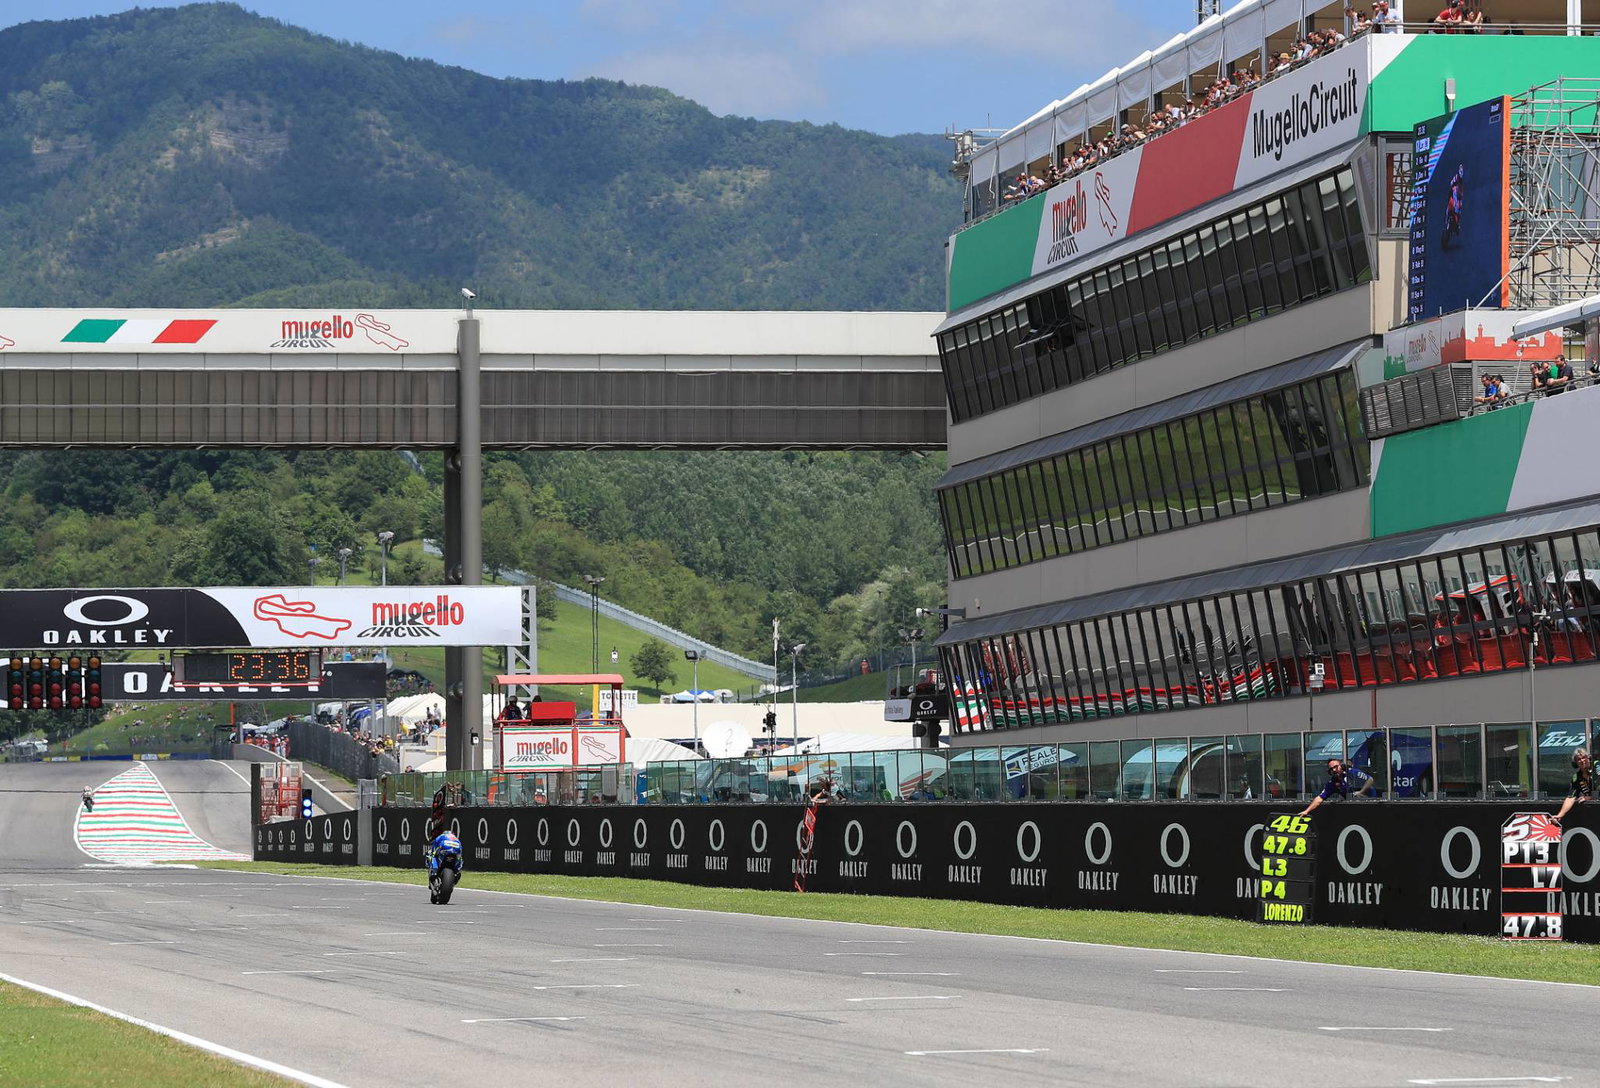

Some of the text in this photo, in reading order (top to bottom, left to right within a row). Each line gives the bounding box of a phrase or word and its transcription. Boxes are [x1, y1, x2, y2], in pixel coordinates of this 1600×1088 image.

[1253, 68, 1358, 161] MugelloCircuit
[1052, 180, 1087, 243] mugello
[1047, 234, 1079, 265] CIRCUIT
[282, 315, 353, 340] mugello
[270, 339, 336, 348] CIRCUIT
[372, 594, 464, 626] mugello
[43, 630, 169, 644] OAKLEY
[357, 626, 441, 639] CIRCUIT
[230, 654, 311, 681] 23:36
[516, 737, 568, 756] mugello
[1270, 815, 1311, 834] 46
[1263, 835, 1307, 855] 47.8
[1503, 842, 1549, 864] P13
[666, 854, 688, 868] OAKLEY
[705, 856, 728, 871] OAKLEY
[747, 857, 771, 873] OAKLEY
[839, 860, 868, 878] OAKLEY
[1263, 858, 1287, 877] L3
[891, 862, 922, 881] OAKLEY
[948, 864, 982, 884] OAKLEY
[1010, 867, 1047, 887] OAKLEY
[1078, 870, 1118, 891] OAKLEY
[1533, 867, 1561, 888] L7
[1153, 874, 1197, 896] OAKLEY
[1261, 880, 1286, 899] P4
[1328, 881, 1382, 905] OAKLEY
[1430, 886, 1490, 911] OAKLEY
[1264, 903, 1304, 922] LORENZO
[1503, 916, 1562, 937] 47.8
